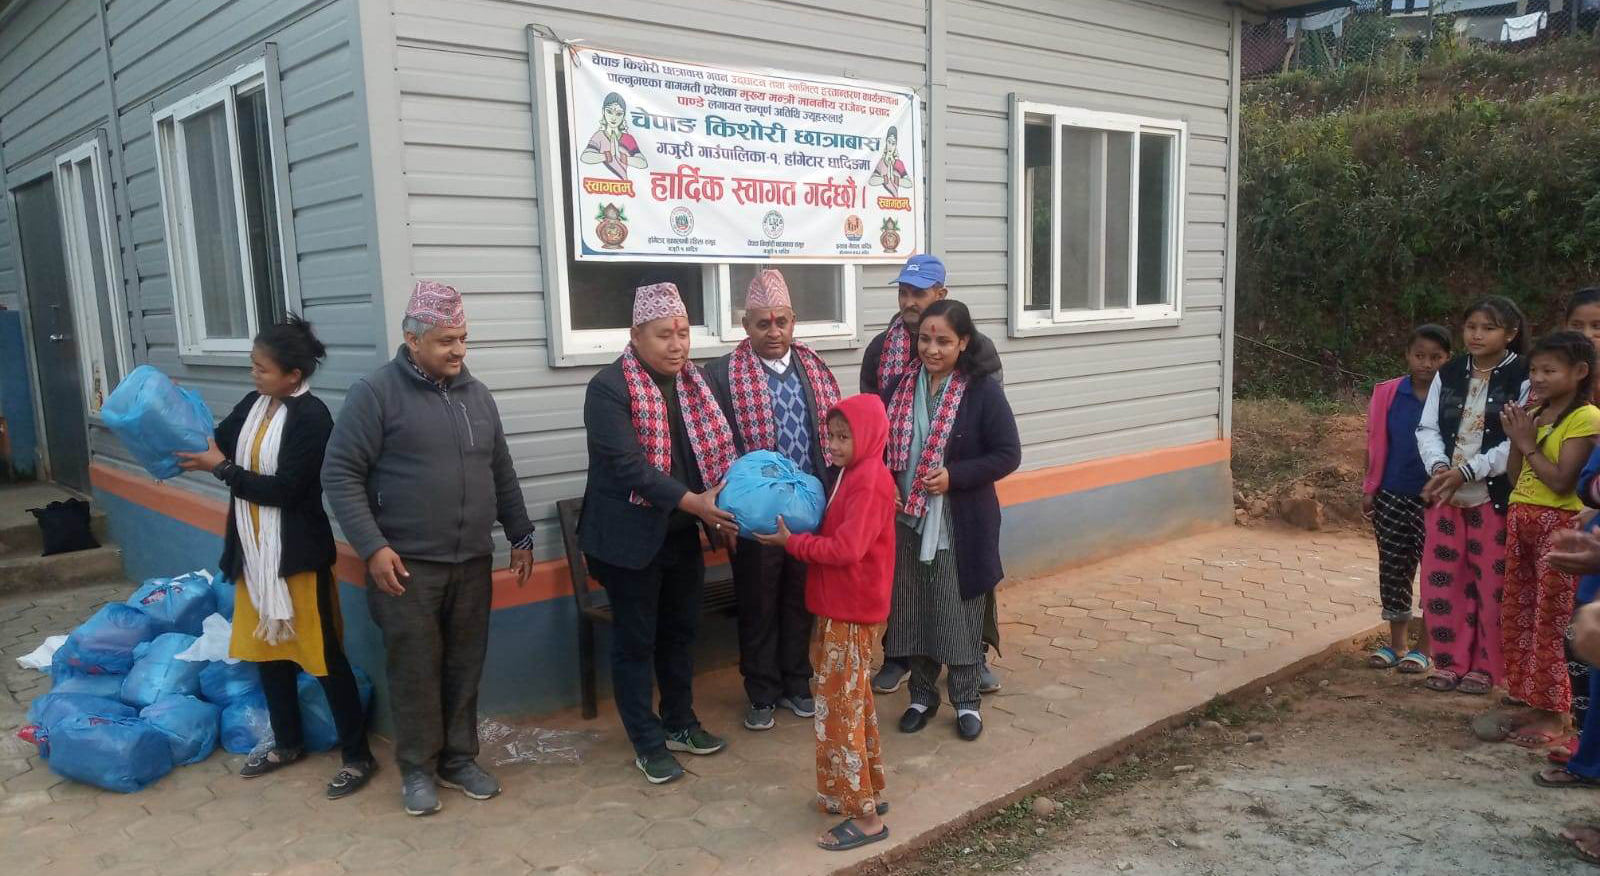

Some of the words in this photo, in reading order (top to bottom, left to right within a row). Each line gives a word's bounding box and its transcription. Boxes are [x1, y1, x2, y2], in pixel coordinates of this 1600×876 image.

[592, 52, 620, 68] चेपाङ
[623, 57, 660, 74] किशोरी
[665, 80, 701, 93] बागमती
[704, 83, 737, 98] प्रदेशका
[798, 96, 836, 110] माननीय
[839, 101, 867, 115] राजेन्द्र
[869, 106, 890, 118] प्रसाद
[677, 96, 705, 108] पाण्डे
[708, 99, 742, 112] लगायत
[744, 103, 772, 118] सम्पूर्ण
[774, 106, 801, 119] अतिथि
[630, 106, 697, 134] चेपाङ
[705, 114, 787, 143] किशोरी
[794, 129, 881, 152] छात्राबास
[656, 140, 694, 160] गजुरी
[583, 177, 636, 198] स्वागतम्
[649, 164, 725, 204] हार्दिक
[731, 177, 798, 207] स्वागत
